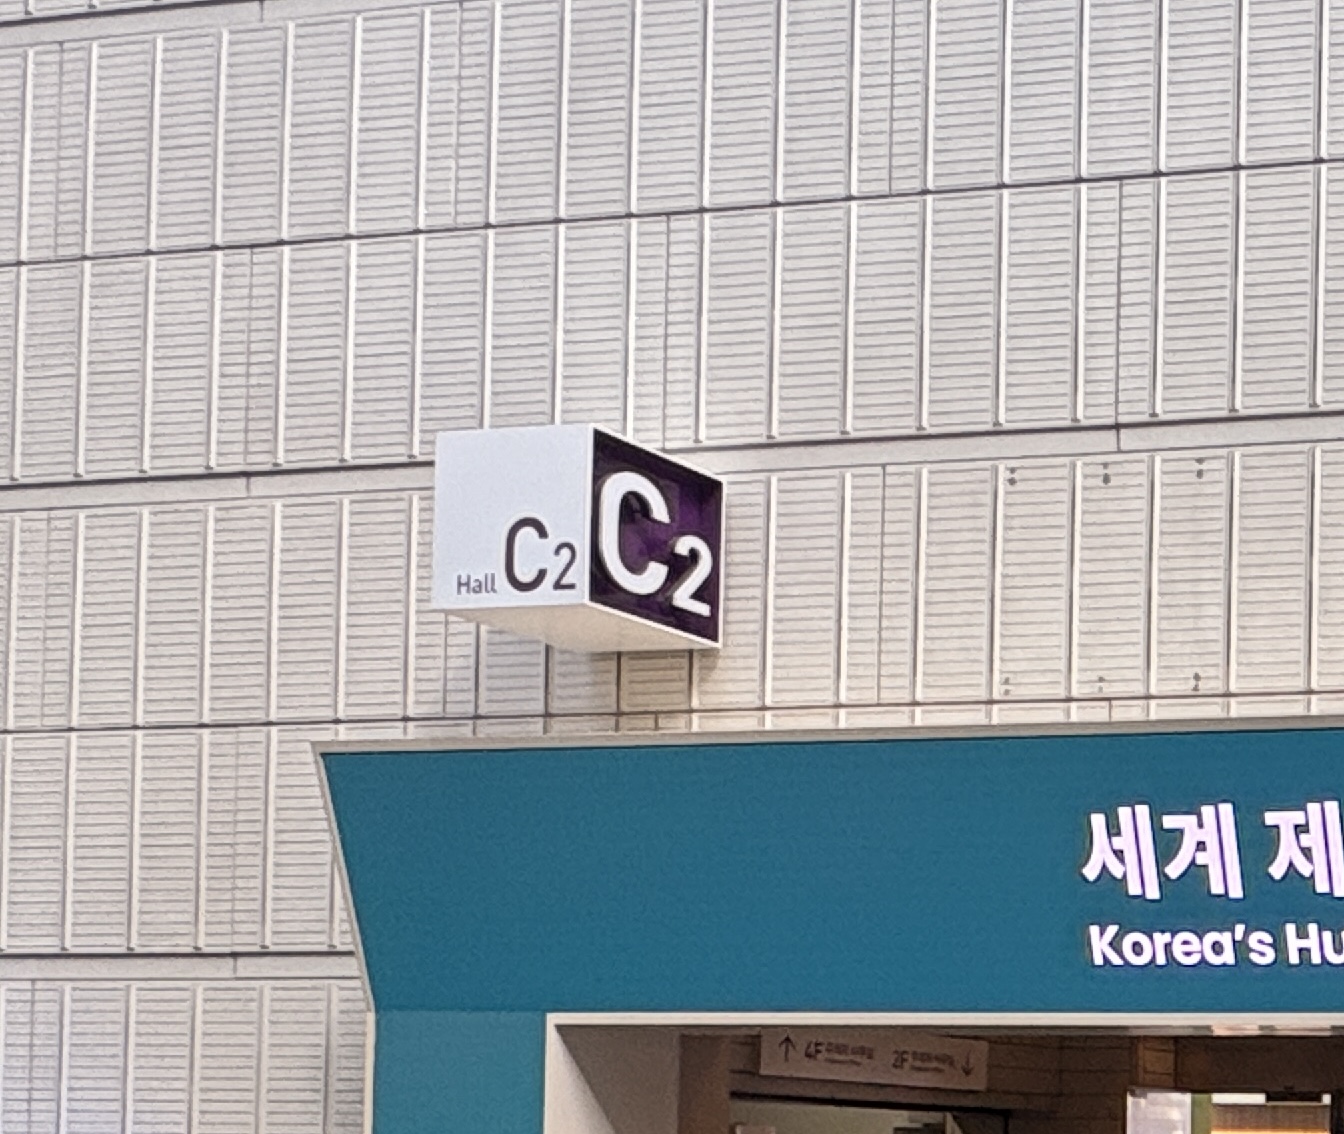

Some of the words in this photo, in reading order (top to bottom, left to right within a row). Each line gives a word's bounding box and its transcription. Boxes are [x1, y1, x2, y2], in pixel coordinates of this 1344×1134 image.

[456, 572, 498, 596] Hall
[504, 516, 578, 592] C2
[602, 470, 712, 618] C2
[1081, 802, 1244, 900] 세계
[1088, 922, 1276, 966] Korea's
